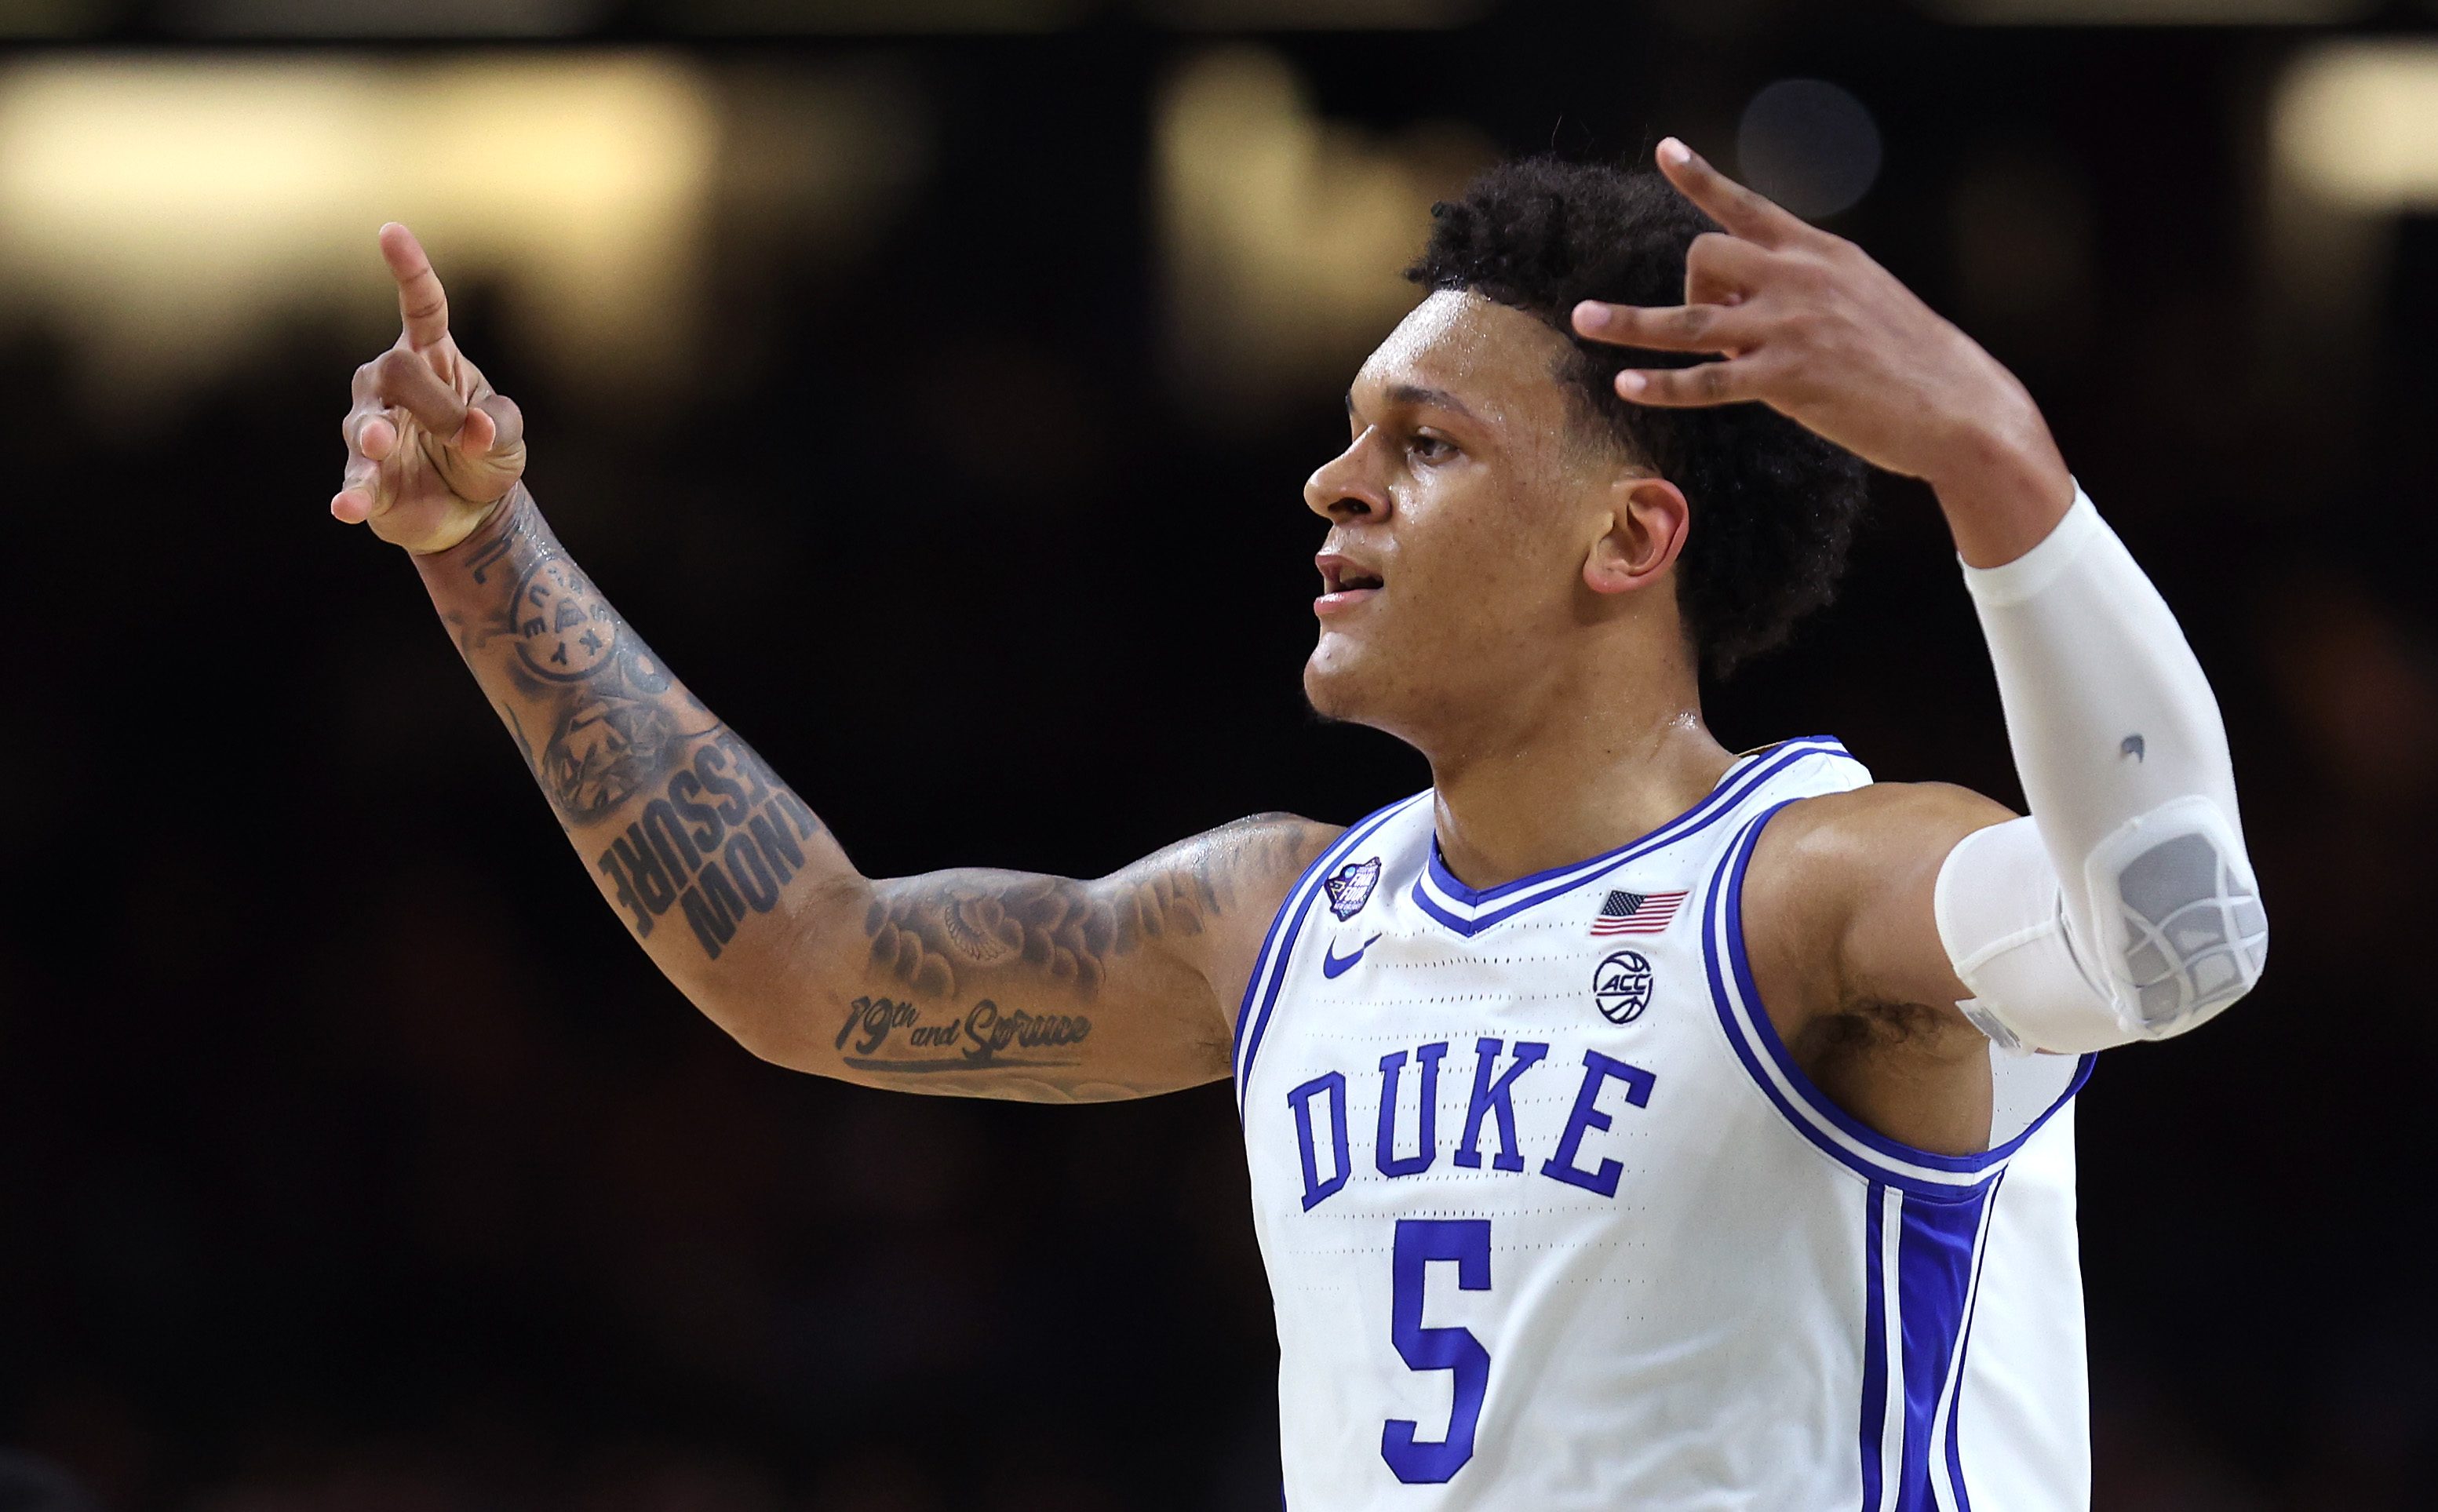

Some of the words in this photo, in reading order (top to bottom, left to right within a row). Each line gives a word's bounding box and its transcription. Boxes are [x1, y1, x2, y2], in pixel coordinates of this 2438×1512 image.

[835, 996, 920, 1055] 19th
[910, 1019, 960, 1047] and
[1601, 974, 1651, 991] ACC
[1287, 1037, 1657, 1213] DUKE
[1380, 1219, 1492, 1485] 5
